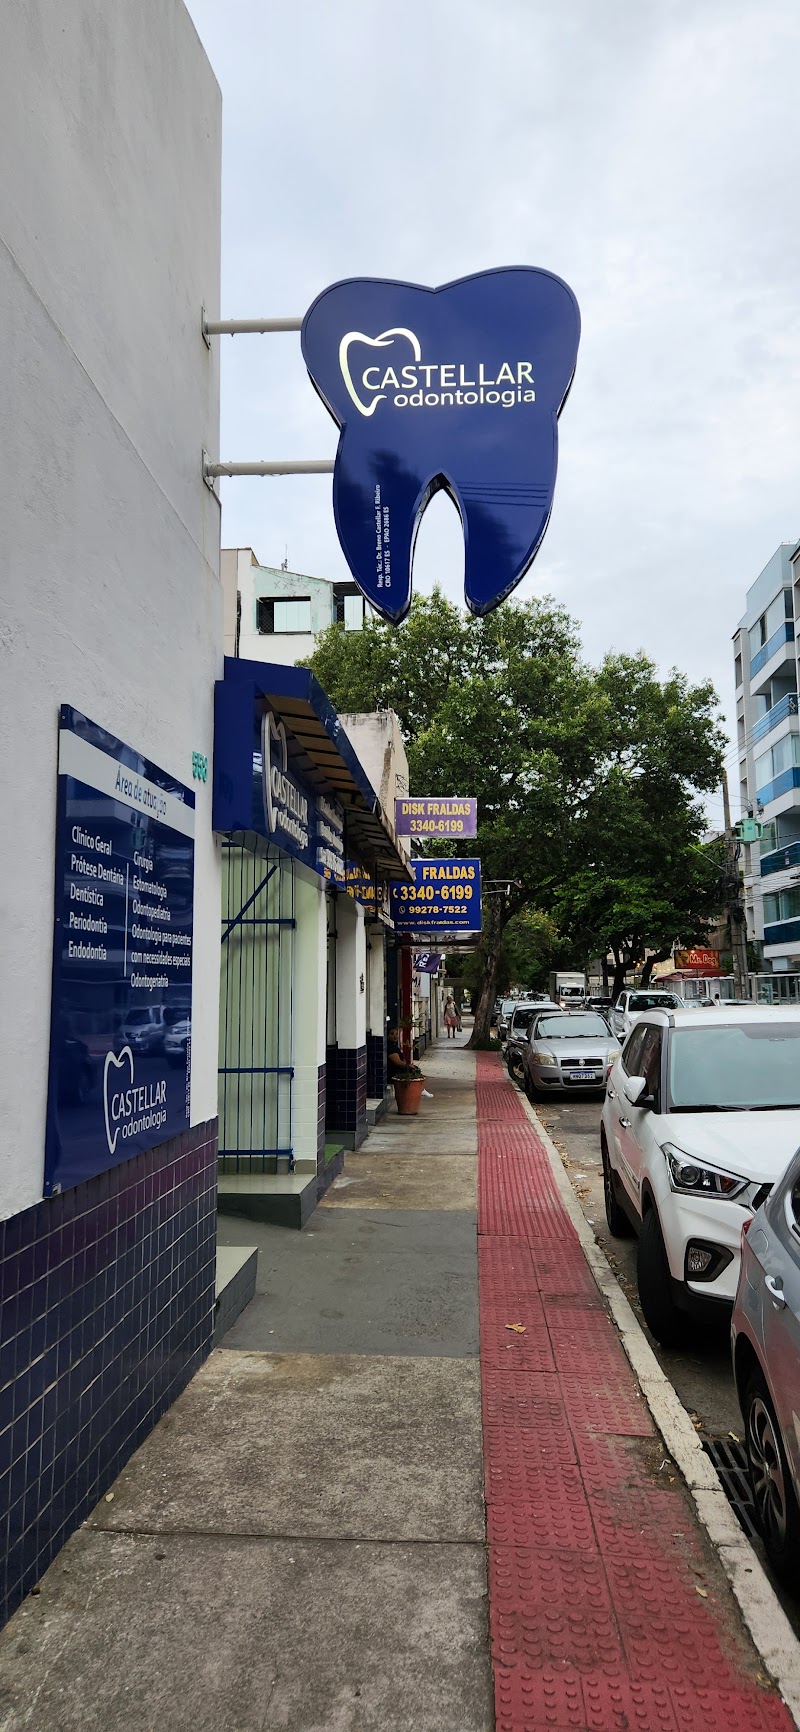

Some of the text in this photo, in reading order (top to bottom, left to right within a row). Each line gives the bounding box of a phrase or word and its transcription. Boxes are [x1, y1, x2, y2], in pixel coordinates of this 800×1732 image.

[362, 361, 535, 390] CASTELLAR
[393, 386, 536, 408] odontologia
[115, 765, 133, 796] Área
[133, 779, 142, 803] de
[270, 765, 308, 826] CASTELLAR
[401, 803, 471, 815] DISK FRALDAS
[410, 819, 464, 832] 3340-6199
[71, 825, 112, 856] Clínico Geral
[71, 854, 124, 886] Prótese Dentária
[133, 851, 153, 873] Cirurgia
[422, 866, 475, 880] FRALDAS
[70, 883, 104, 907] Dentística
[133, 875, 167, 901] Estomatologia
[400, 885, 473, 900] 3340-6199
[132, 899, 170, 921] Odontopediatria
[408, 905, 467, 914] 99278-7522
[69, 911, 107, 934] Periodontia
[132, 924, 191, 947] Odontologia para pacientes
[68, 940, 107, 960] Endodontia
[131, 950, 190, 969] com necessidades especiais
[702, 953, 717, 966] Dog
[130, 972, 169, 992] Odontogeriatria
[111, 1080, 167, 1121] CASTELLAR
[122, 1106, 167, 1139] odontologia
